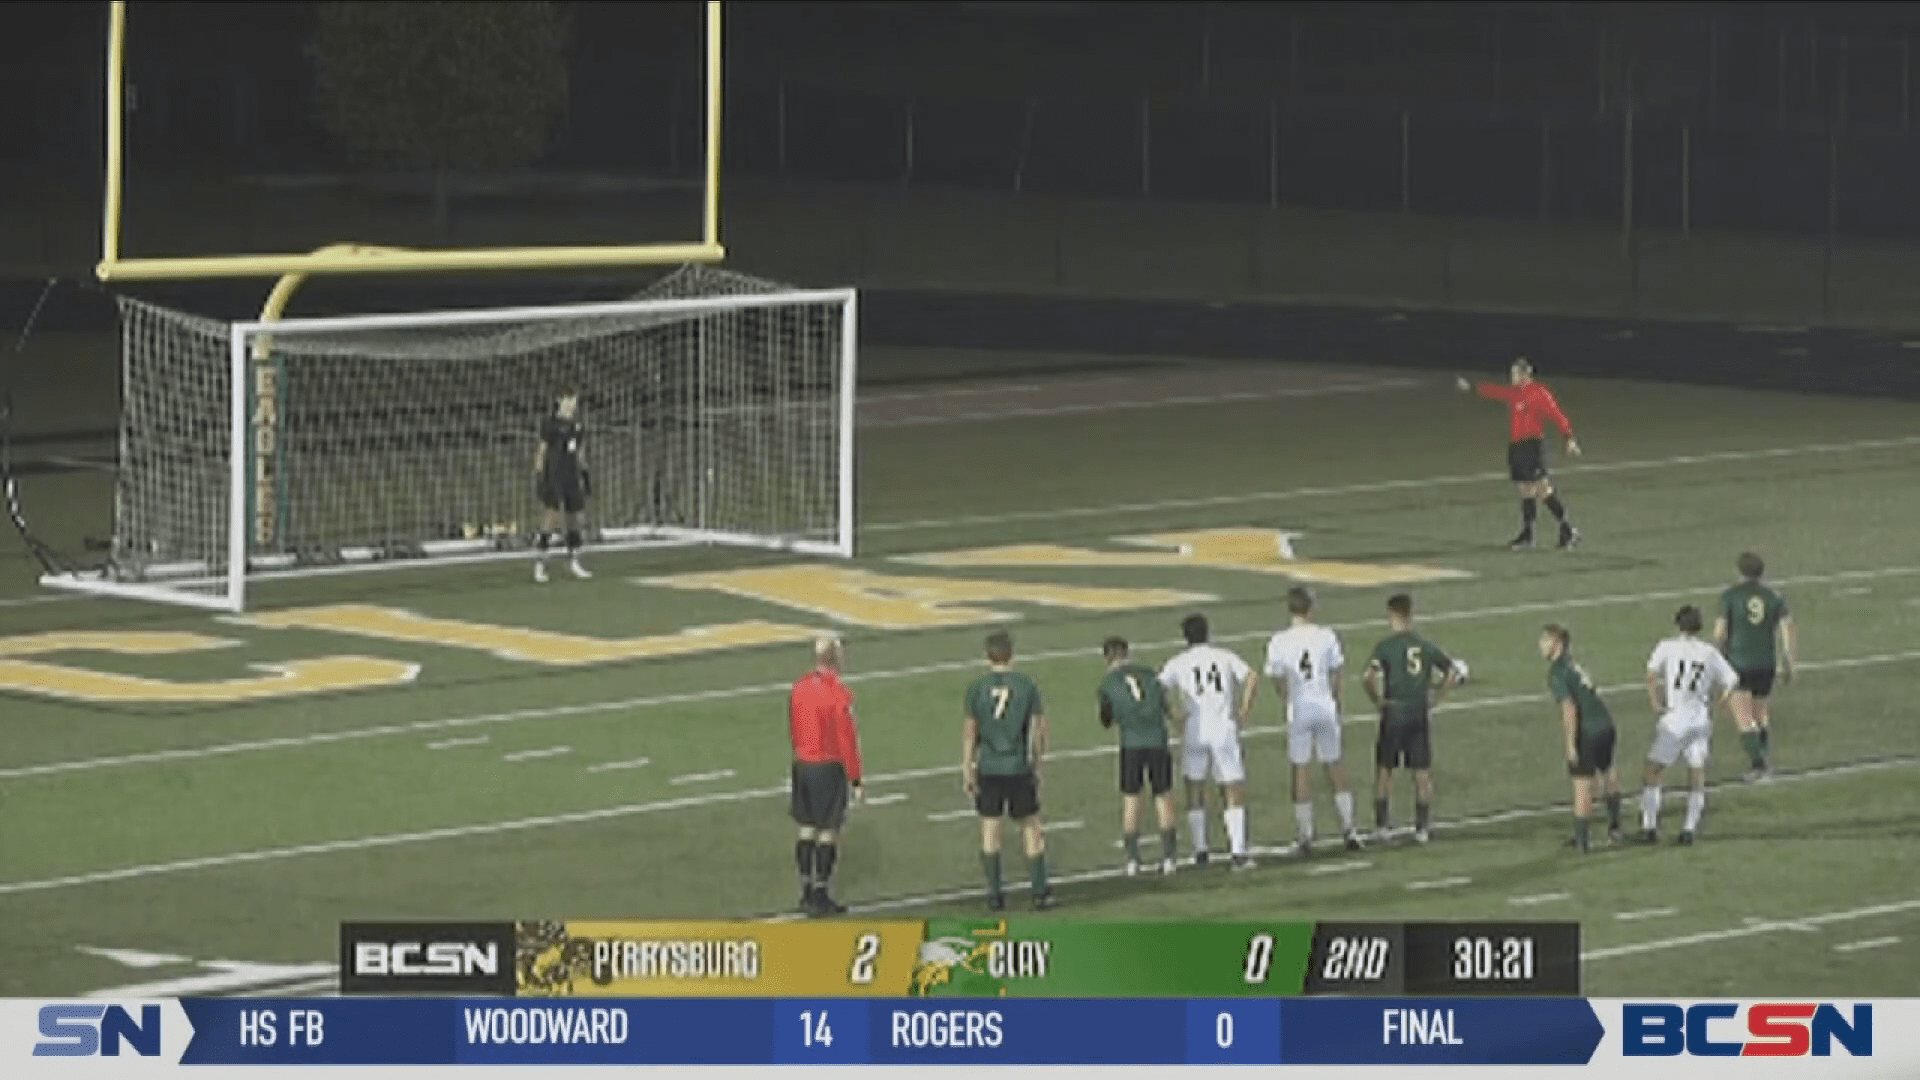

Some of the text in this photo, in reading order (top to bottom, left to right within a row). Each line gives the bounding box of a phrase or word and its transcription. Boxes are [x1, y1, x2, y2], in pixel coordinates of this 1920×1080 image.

[1747, 595, 1765, 625] 9
[1299, 648, 1313, 680] 4
[1406, 646, 1423, 676] 5
[1191, 662, 1223, 696] 14
[990, 686, 1010, 719] 7
